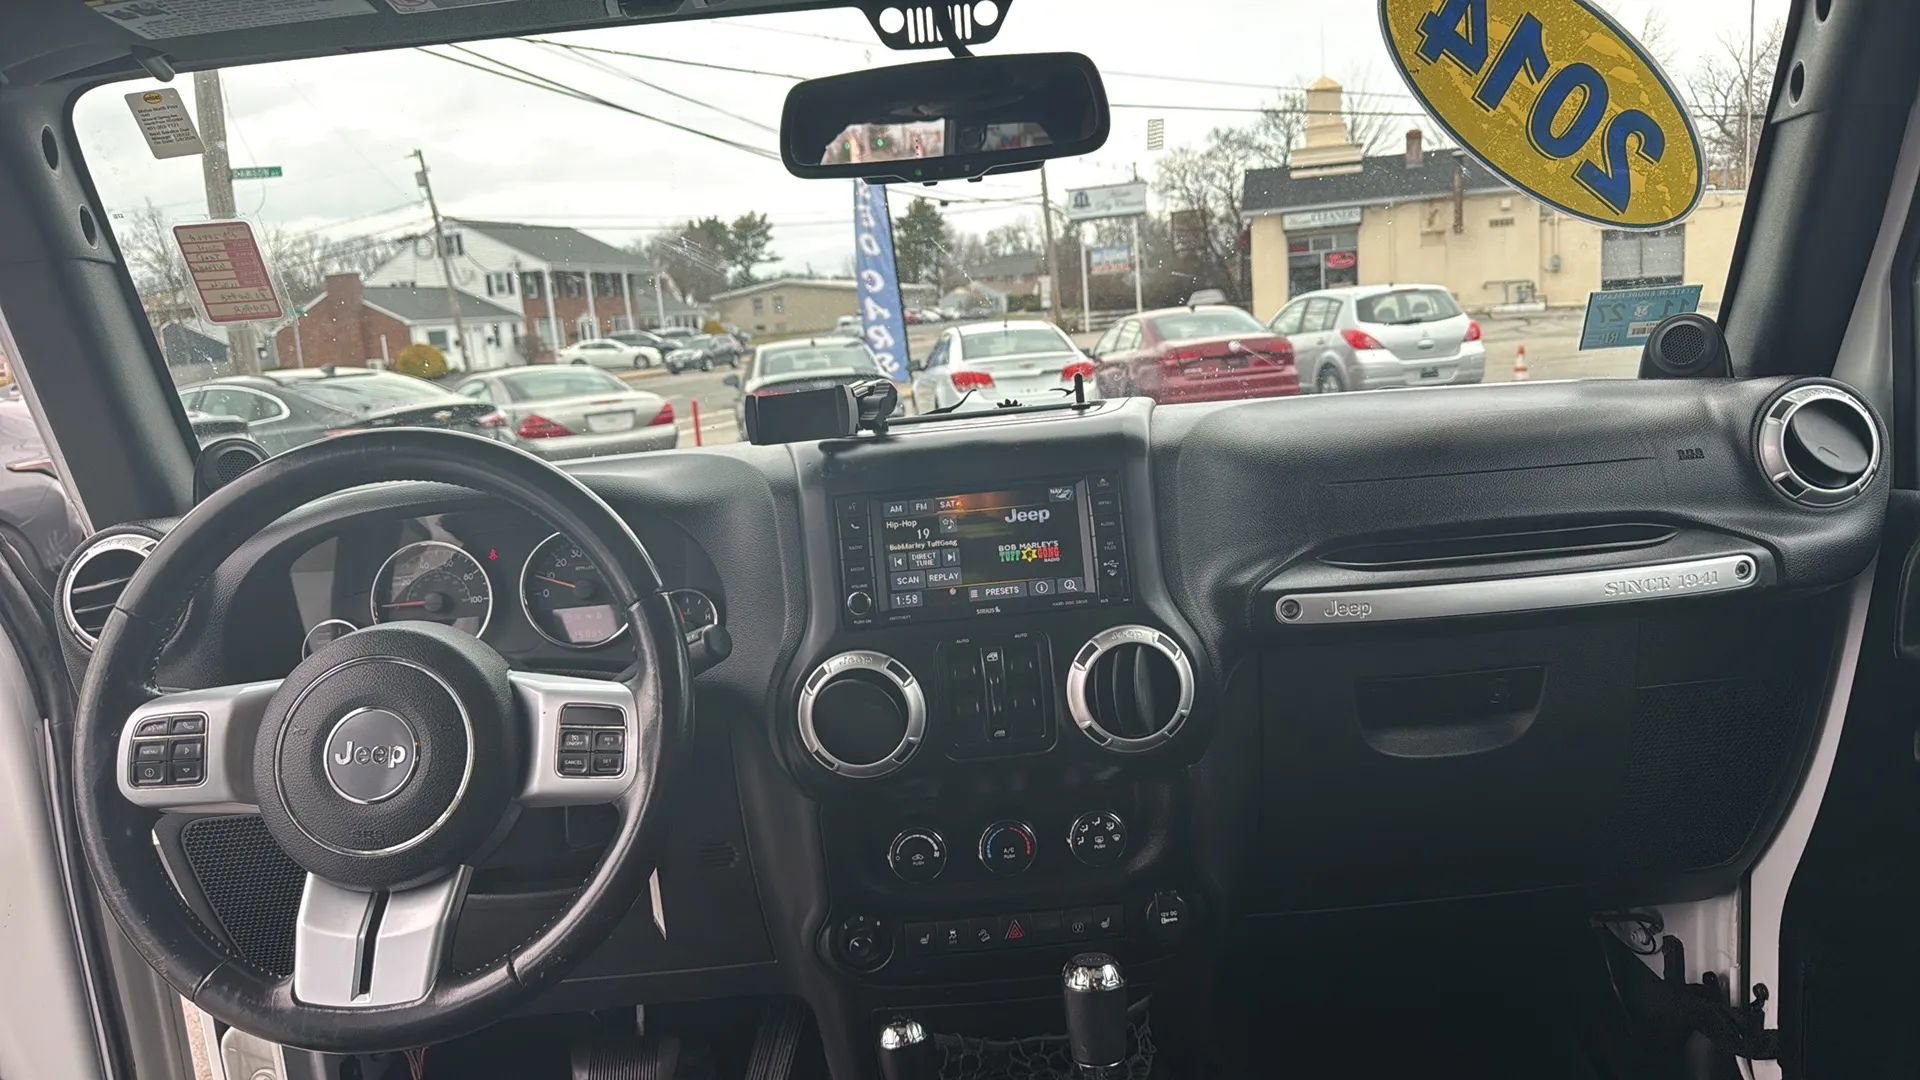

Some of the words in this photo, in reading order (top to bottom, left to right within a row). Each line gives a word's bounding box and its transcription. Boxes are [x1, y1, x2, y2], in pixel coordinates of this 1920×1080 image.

[916, 503, 927, 511] FM
[940, 500, 955, 508] SAT
[890, 505, 902, 513] AM
[1005, 508, 1050, 523] Jeep
[886, 520, 918, 530] Hip-Hop
[917, 528, 930, 540] 19
[998, 544, 1017, 552] BOB
[1019, 540, 1059, 550] MARLEY'S
[912, 552, 936, 560] DIRECT
[555, 558, 567, 567] 20
[897, 576, 919, 585] SCAN
[929, 573, 959, 582] REPLAY
[1604, 576, 1671, 596] SINCE
[1678, 571, 1720, 588] 1941
[543, 589, 550, 597] 0
[985, 586, 1019, 596] PRESETS
[896, 595, 918, 605] 1:58
[976, 607, 995, 615] SIRIUS
[1324, 600, 1372, 619] Jeep
[335, 741, 406, 768] Jeep
